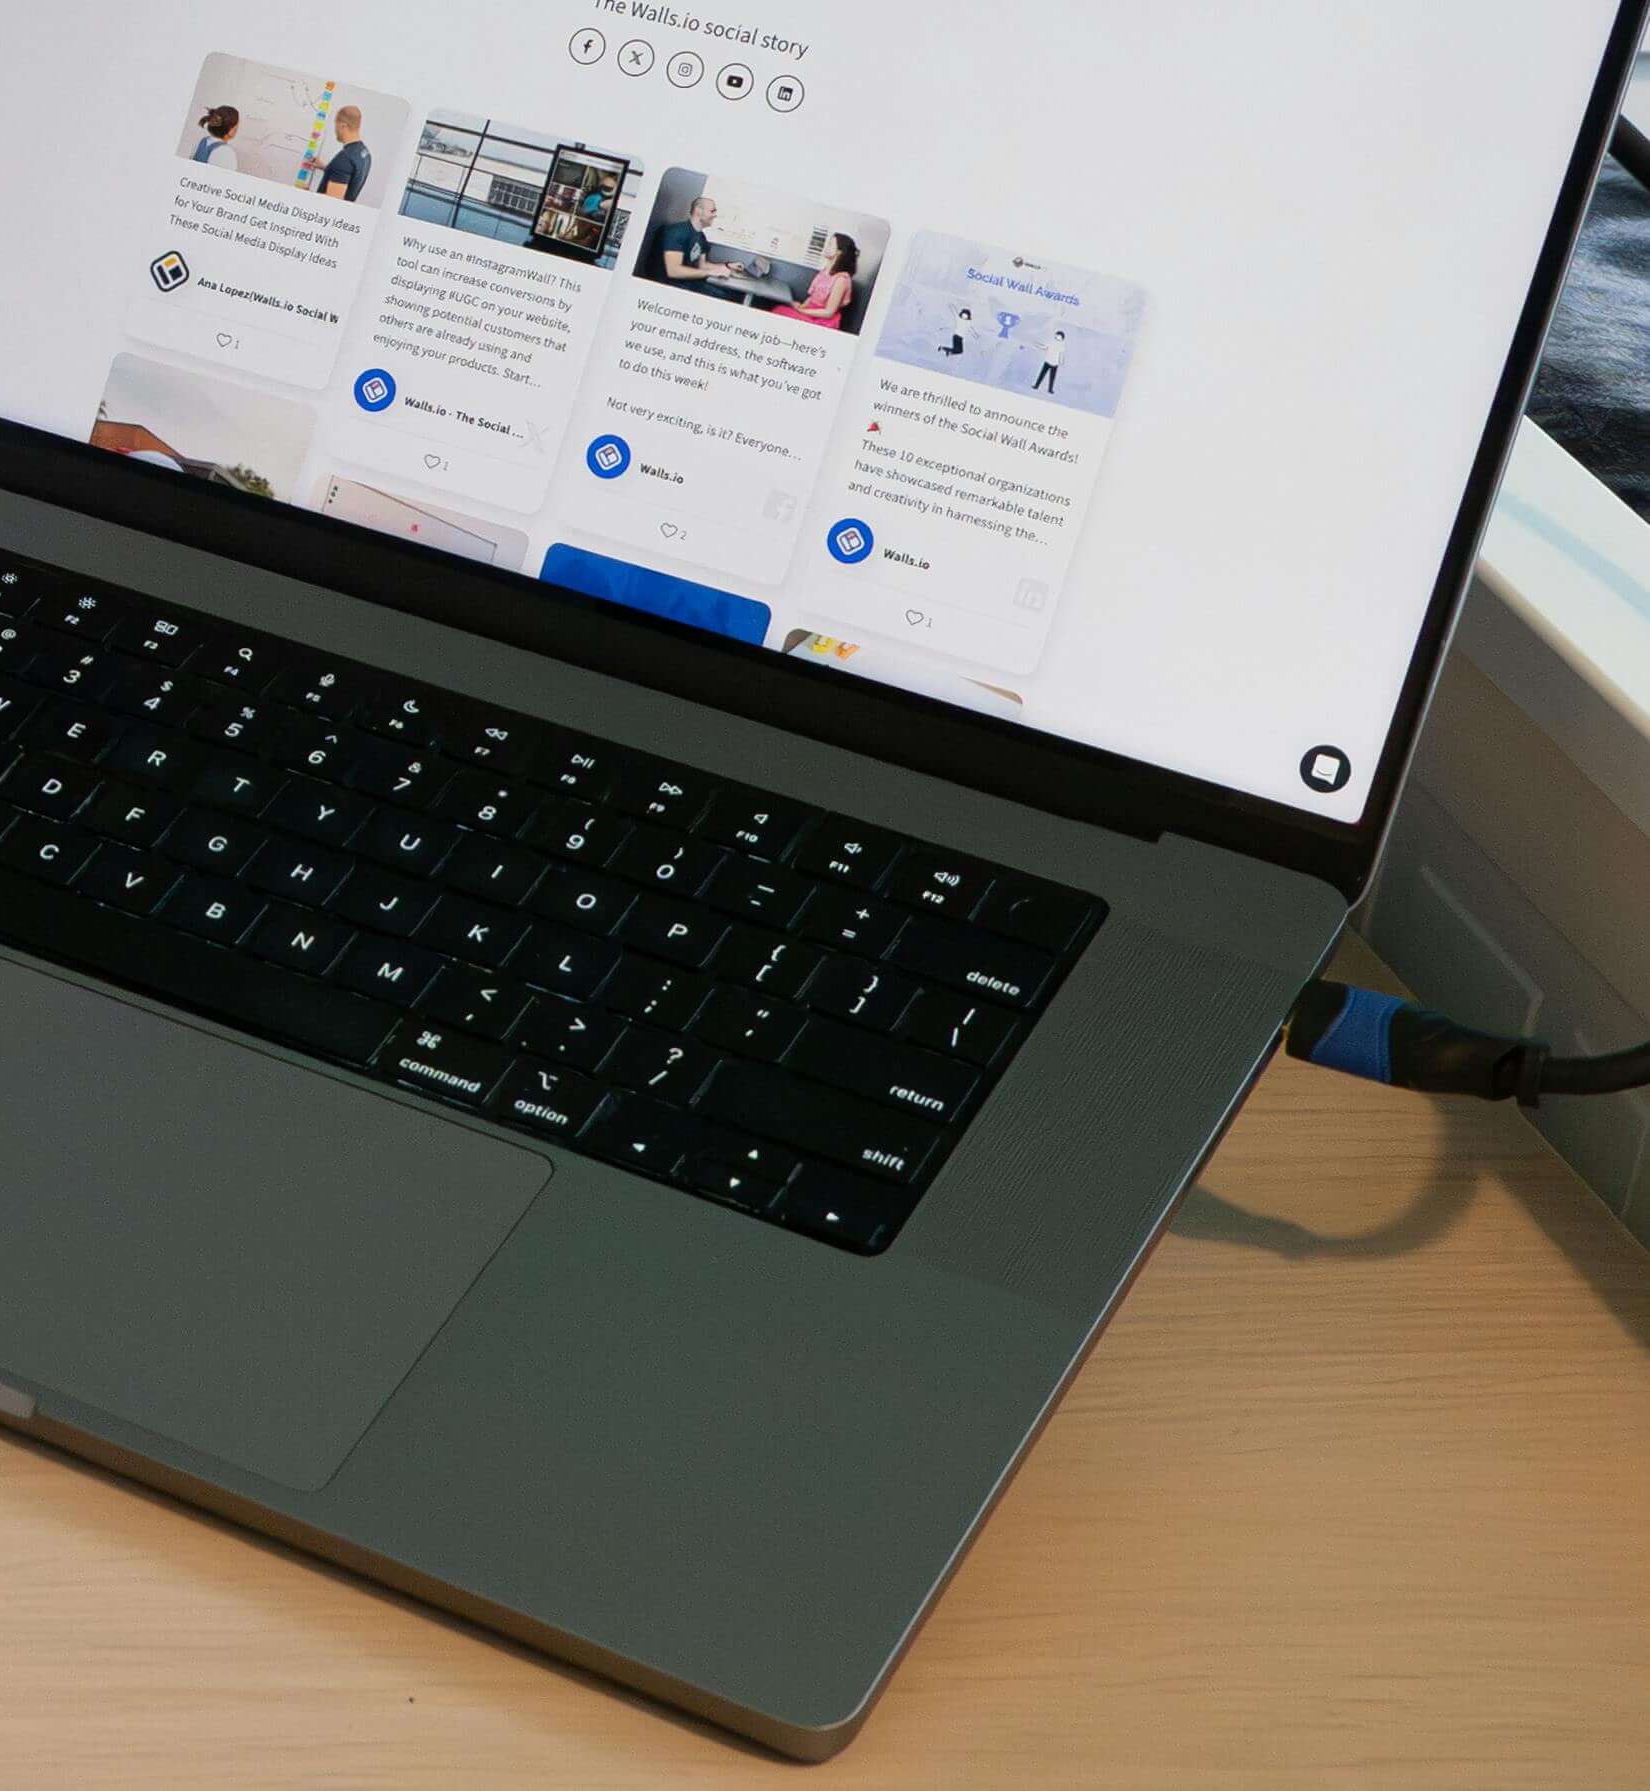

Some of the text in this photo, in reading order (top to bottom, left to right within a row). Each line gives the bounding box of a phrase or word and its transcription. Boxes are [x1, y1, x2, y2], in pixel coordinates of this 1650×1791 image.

[631, 1, 700, 32] Walls.io
[703, 21, 759, 46] social
[760, 34, 809, 61] story
[179, 176, 361, 234] Creative Social Media Display Ideas
[966, 267, 1080, 307] Social Wall Awards
[404, 396, 511, 435] Walls.io The Social
[640, 463, 684, 485] Walls.io
[883, 548, 930, 570] Walls.io
[966, 971, 1020, 996] delete
[399, 1058, 481, 1093] command
[889, 1085, 944, 1111] return
[514, 1099, 568, 1125] option
[862, 1149, 905, 1171] shift
